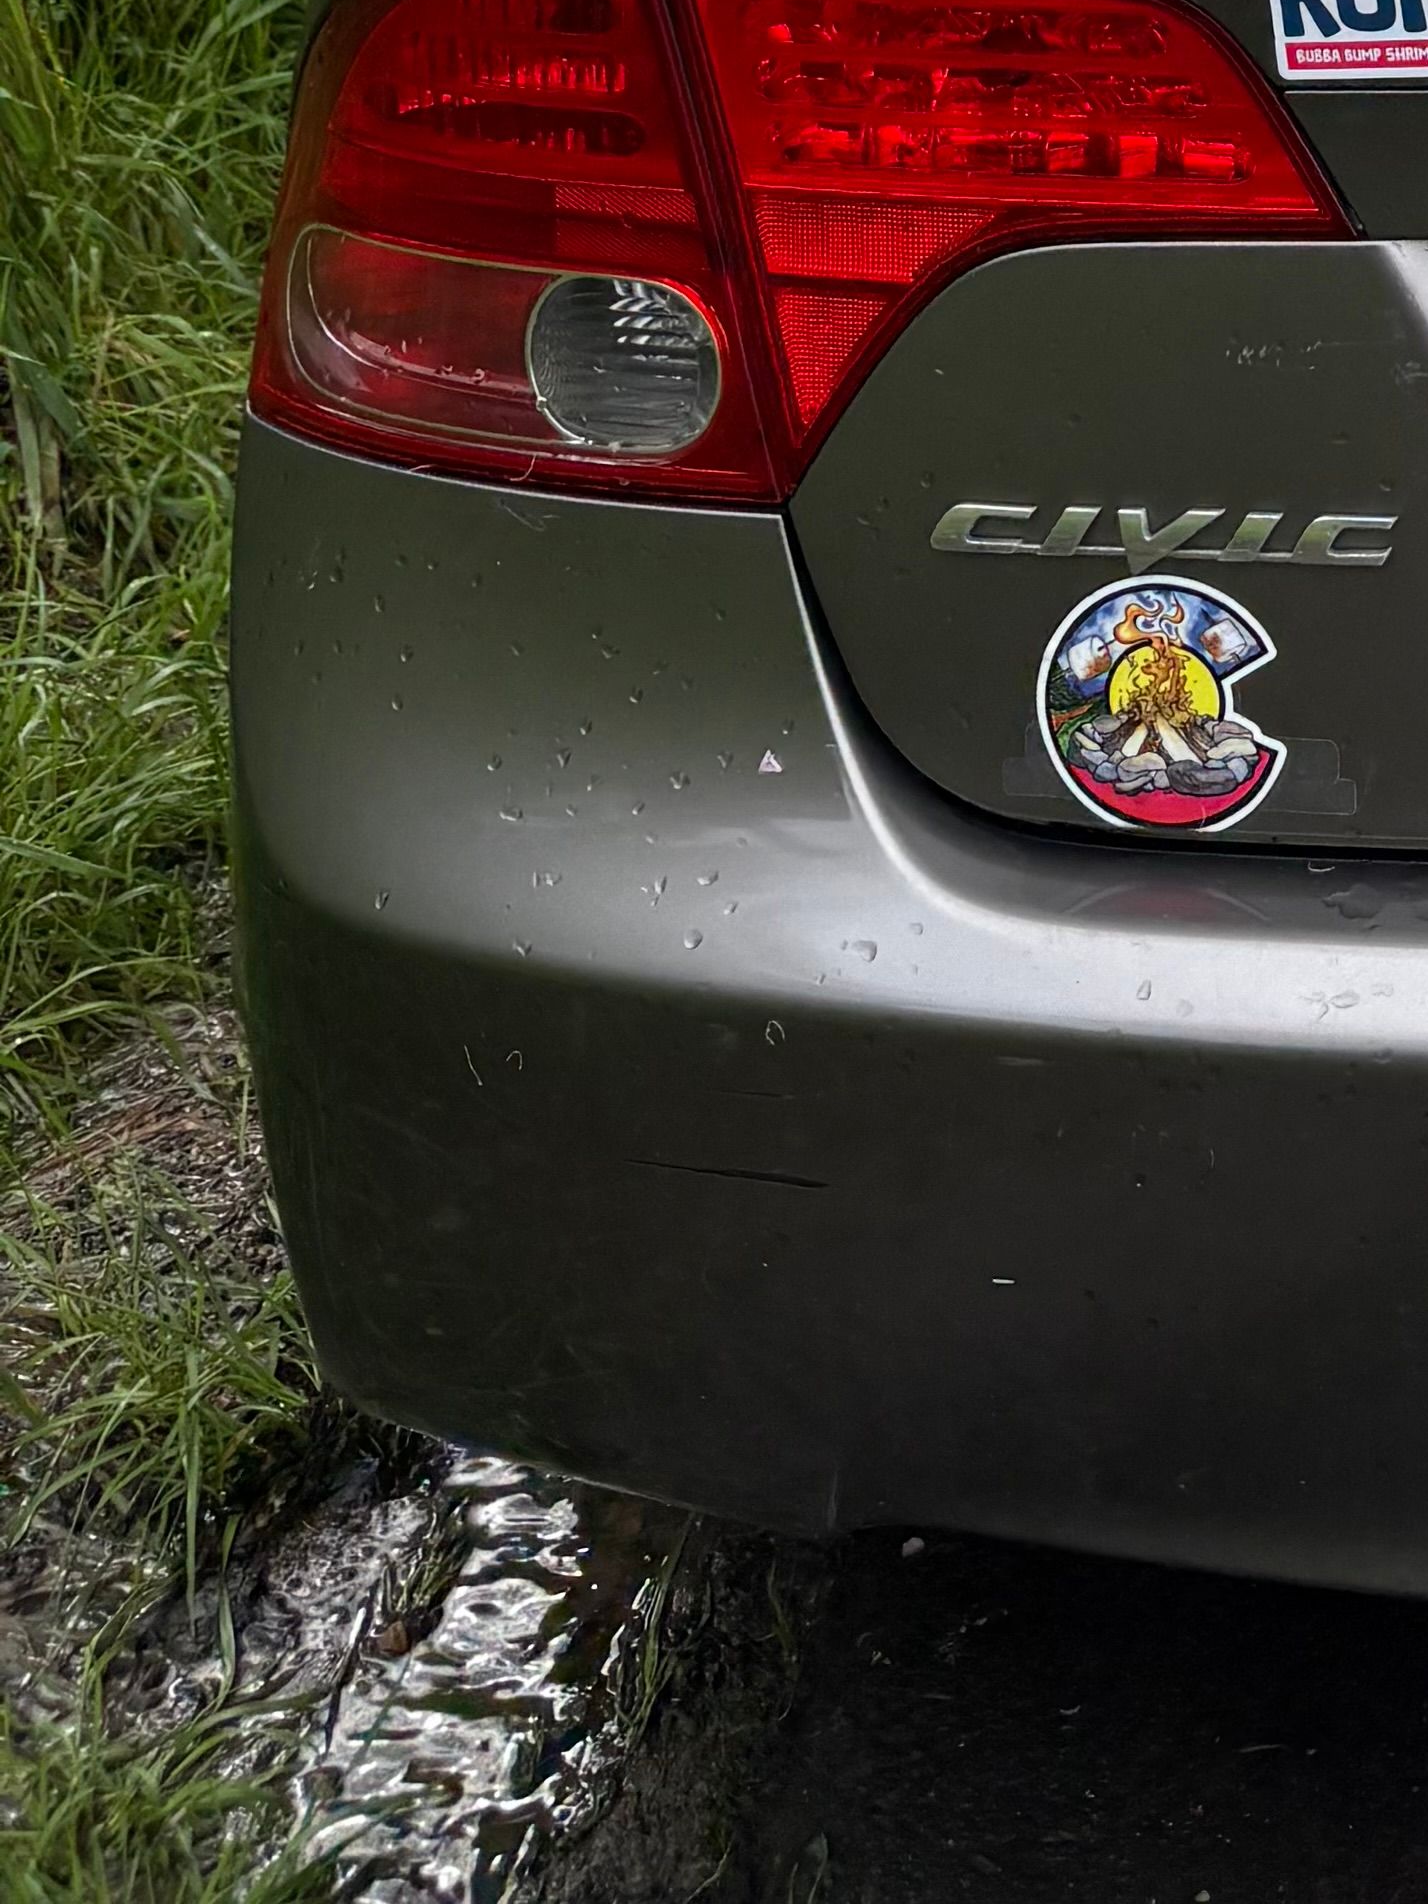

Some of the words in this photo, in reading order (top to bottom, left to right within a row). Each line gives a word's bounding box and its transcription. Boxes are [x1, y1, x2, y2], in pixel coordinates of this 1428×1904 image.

[1296, 48, 1342, 64] BUBBA
[1344, 48, 1381, 62] GUMP
[930, 502, 1400, 575] CIVIC
